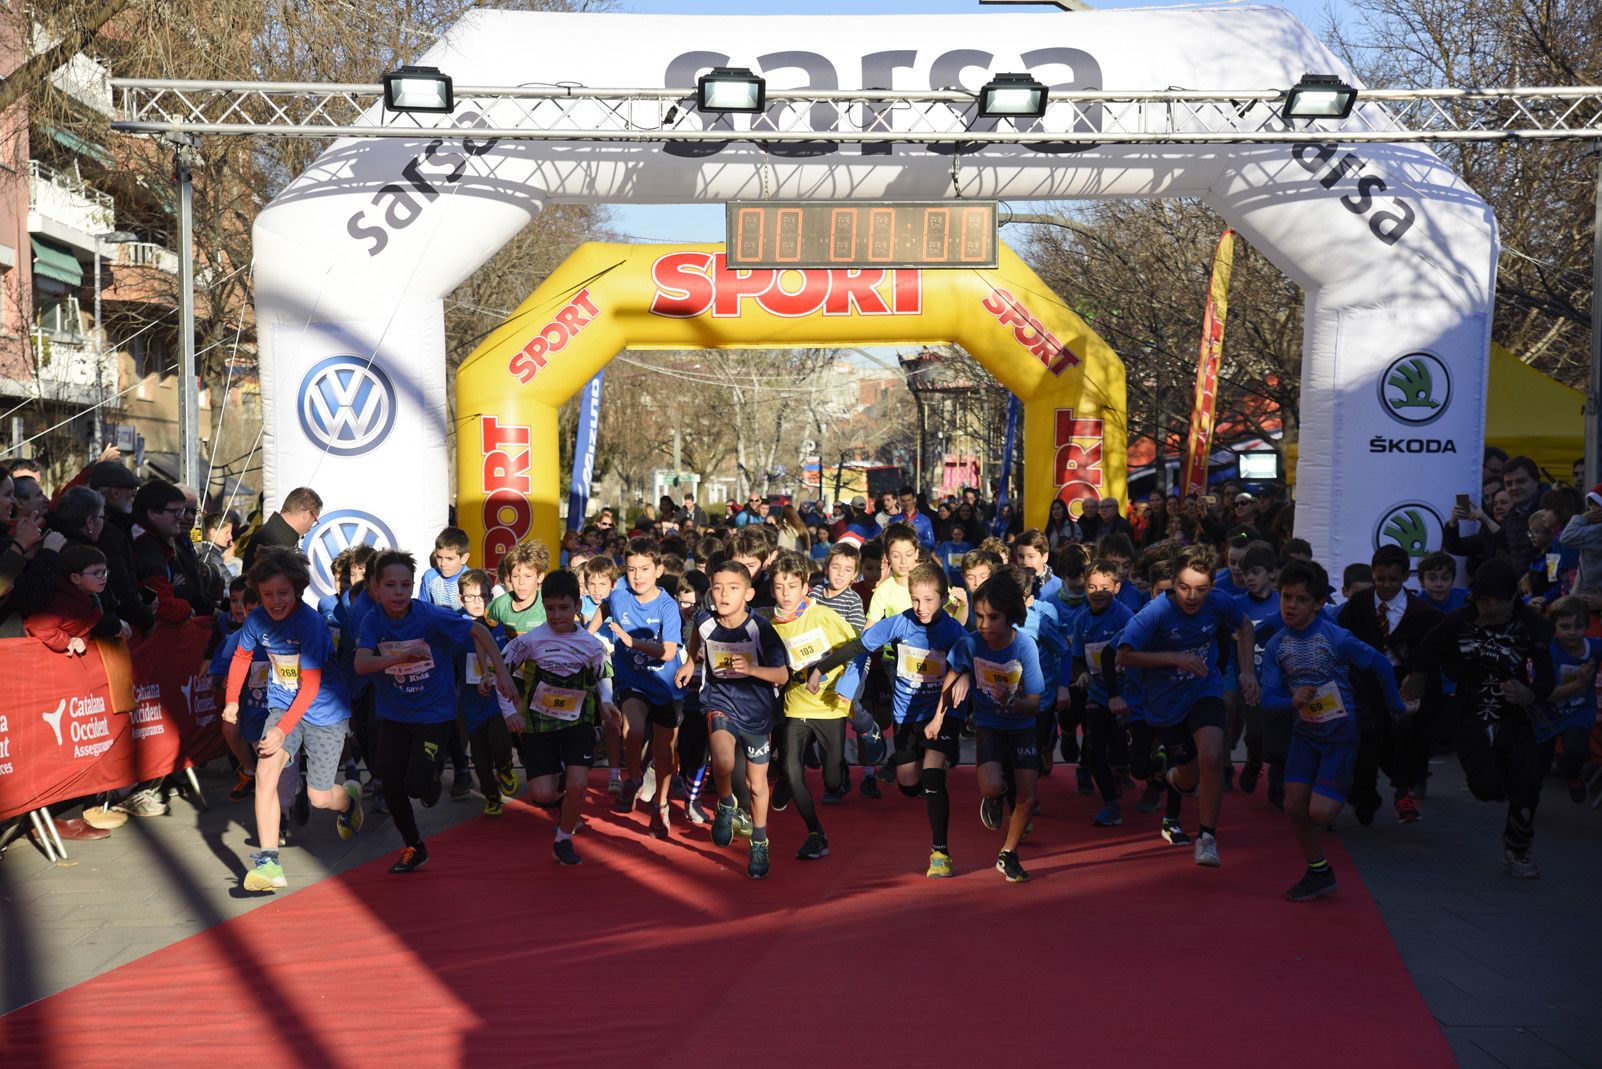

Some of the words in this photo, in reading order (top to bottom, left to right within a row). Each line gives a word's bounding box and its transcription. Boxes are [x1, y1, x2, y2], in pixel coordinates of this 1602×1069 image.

[664, 47, 1104, 157] sarsa
[508, 287, 600, 385] SPORT
[980, 287, 1082, 377] SPORT
[1369, 435, 1456, 453] ŠKODA
[481, 415, 532, 586] PORT
[800, 645, 814, 657] 103
[281, 668, 297, 678] 268
[69, 693, 106, 718] Catalana
[70, 716, 110, 742] Occident
